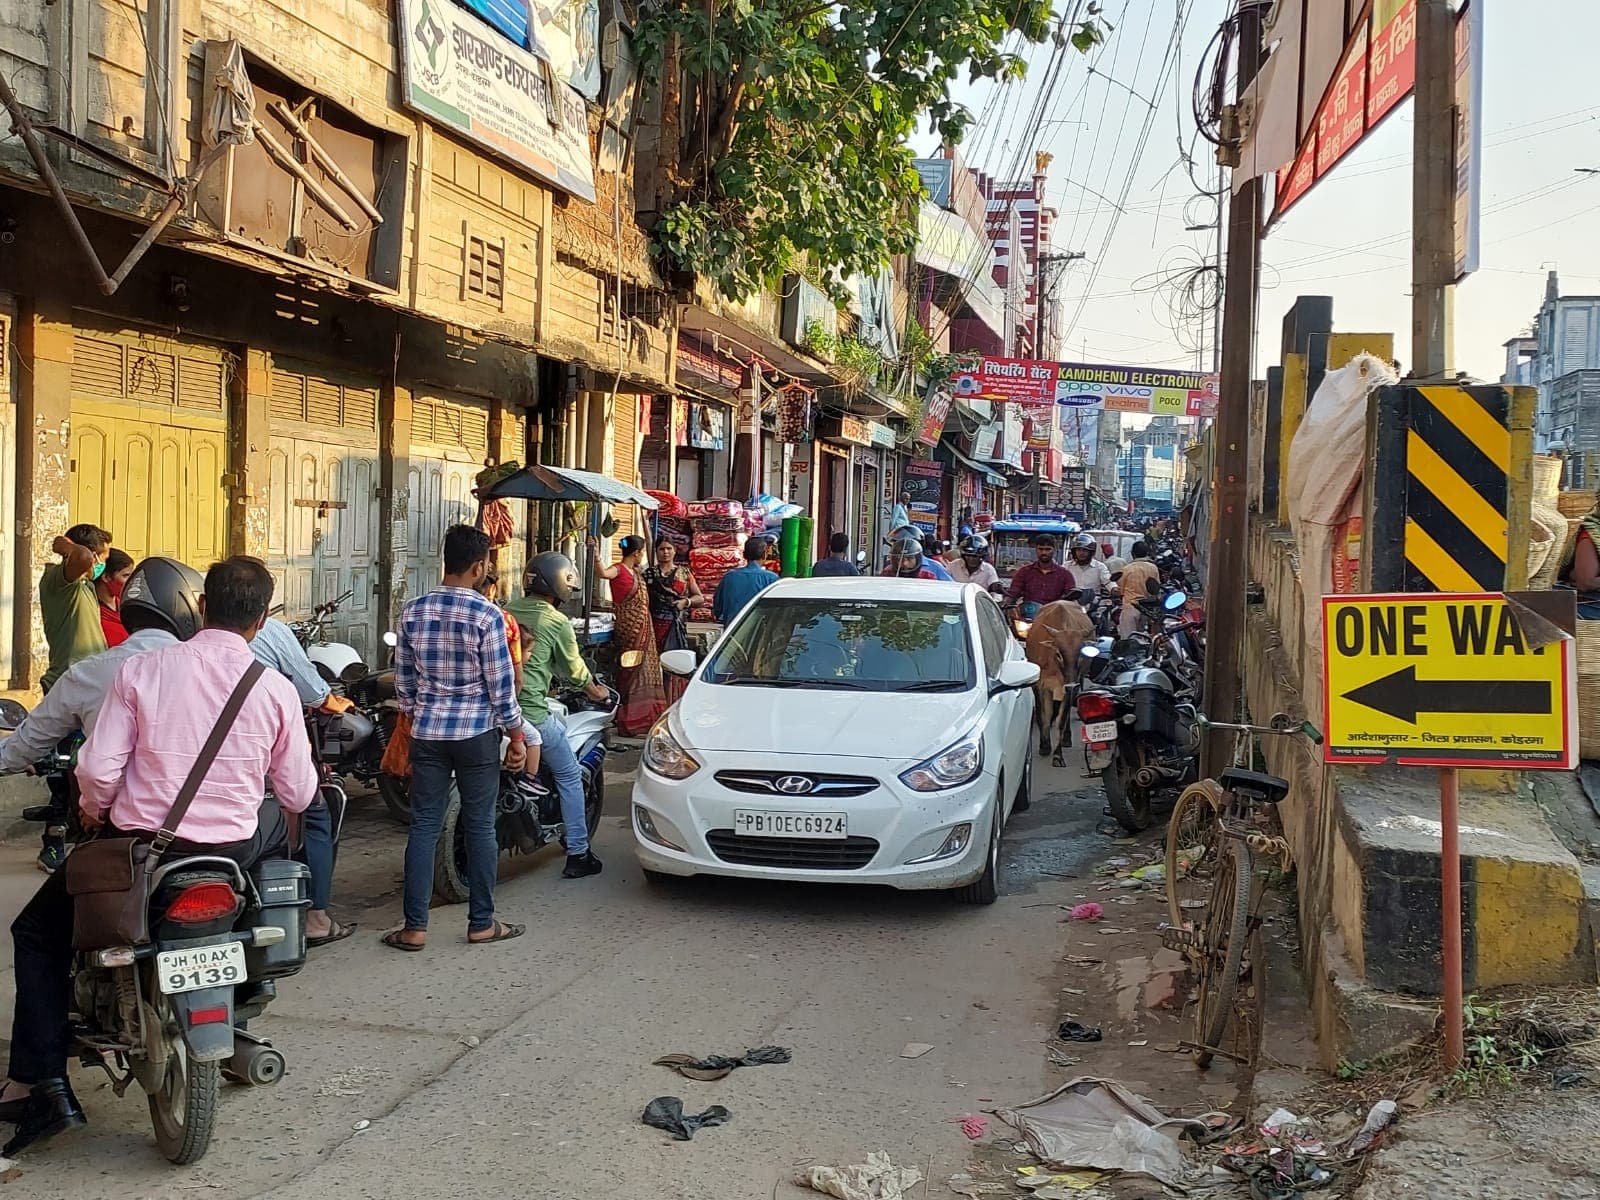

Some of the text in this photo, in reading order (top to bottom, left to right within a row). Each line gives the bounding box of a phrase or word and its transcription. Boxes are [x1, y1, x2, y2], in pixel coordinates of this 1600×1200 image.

[1058, 367, 1128, 384] KAMDHENU
[1063, 396, 1097, 404] SAMSUNG
[1107, 400, 1148, 409] realme
[1159, 397, 1181, 406] POCO
[1335, 604, 1544, 657] ONE WA
[1347, 731, 1409, 745] आदेशानुसार
[1422, 732, 1450, 743] जिला
[1500, 734, 1544, 745] कोडरमा
[746, 815, 843, 833] PB10EC6924
[171, 950, 229, 967] JH 10 AX
[169, 965, 238, 989] 9139
